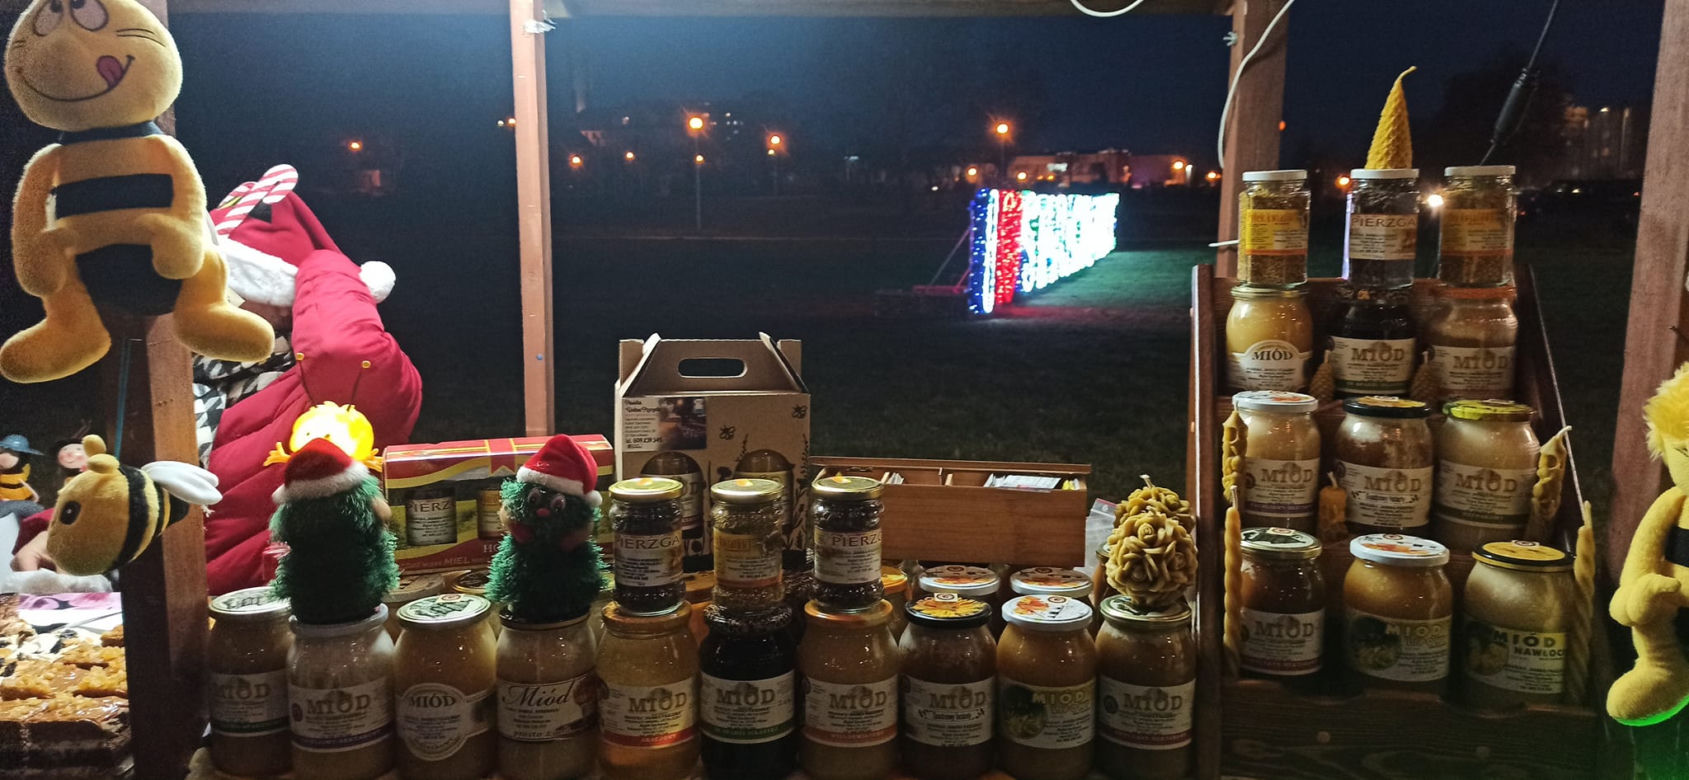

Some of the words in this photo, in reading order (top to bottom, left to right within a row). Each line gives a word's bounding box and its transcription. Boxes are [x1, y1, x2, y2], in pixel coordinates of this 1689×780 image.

[1252, 348, 1294, 361] MIÓD
[406, 501, 450, 513] PIERZ
[617, 535, 680, 550] IERZGA
[408, 693, 457, 709] MIÓD
[501, 680, 576, 708] Miód
